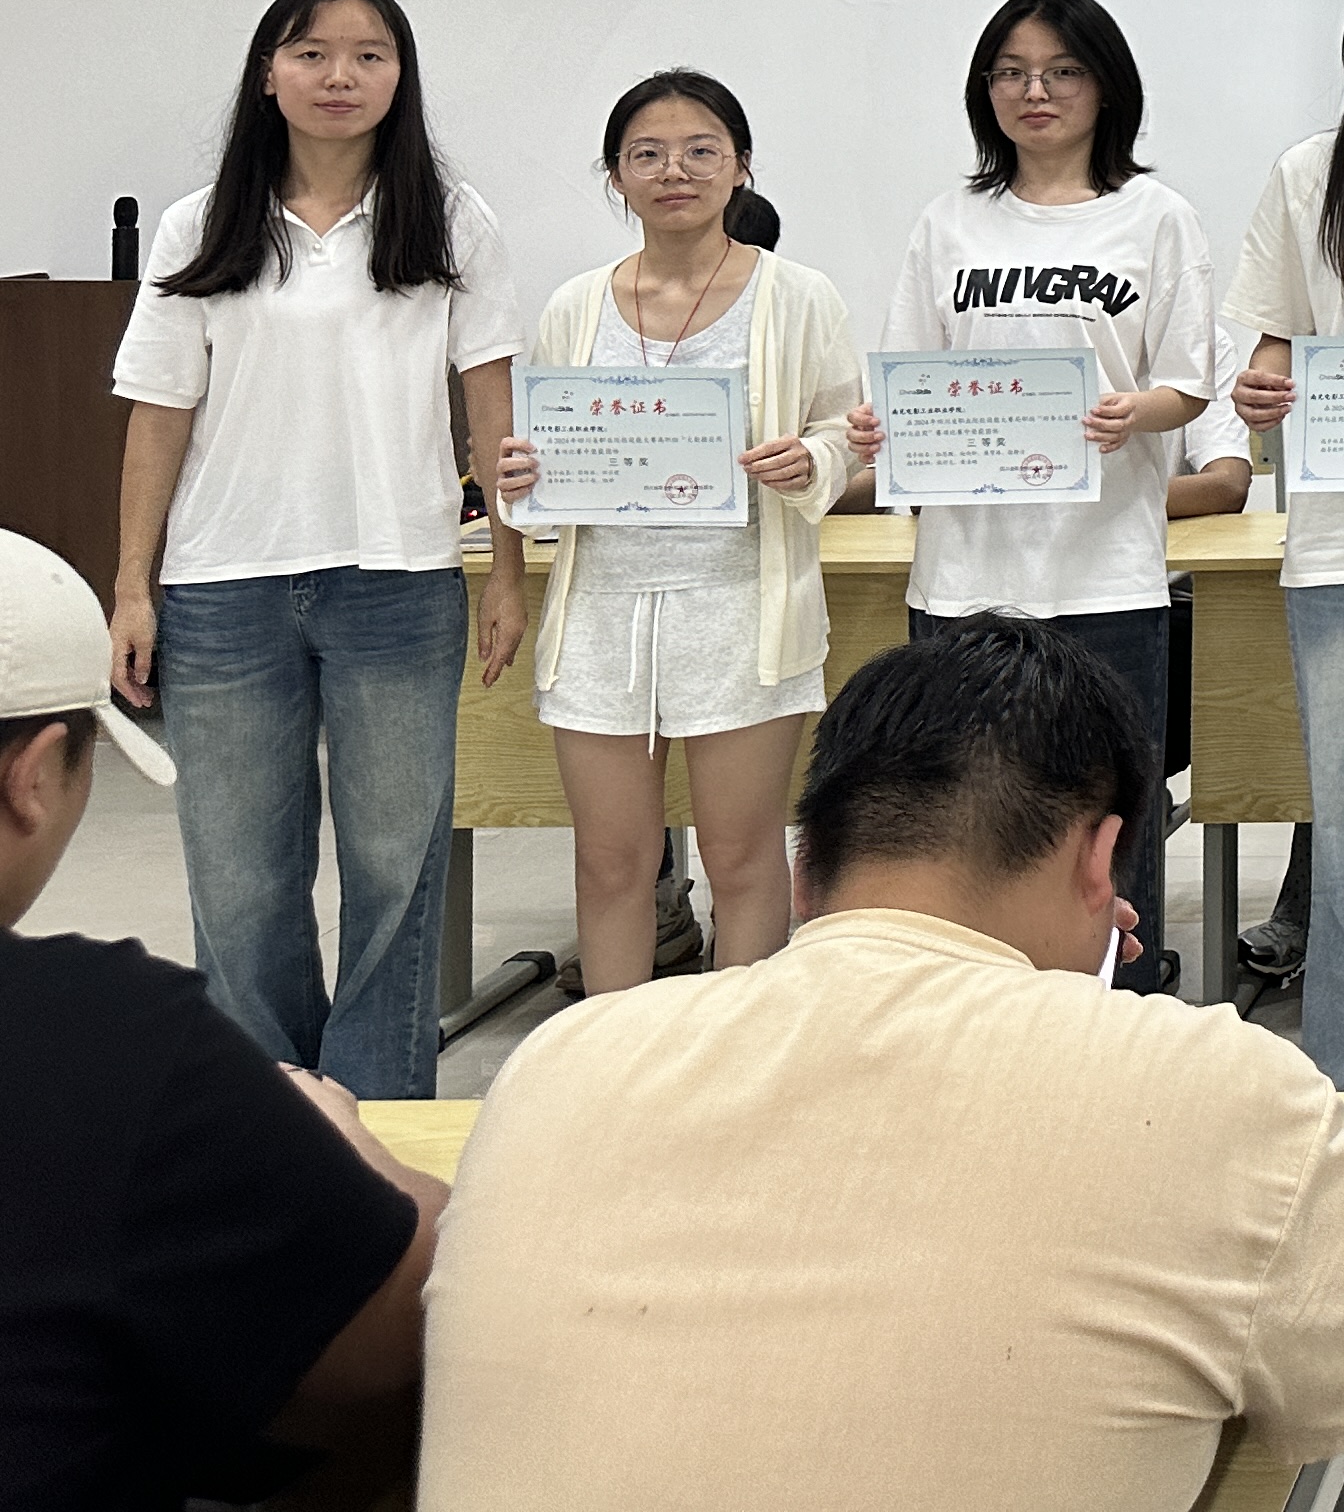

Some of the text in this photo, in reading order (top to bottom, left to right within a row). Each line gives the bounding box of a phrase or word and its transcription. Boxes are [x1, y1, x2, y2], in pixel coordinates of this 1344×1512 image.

[947, 378, 1024, 397] 荣誉证书
[589, 397, 667, 416] 荣誉证书
